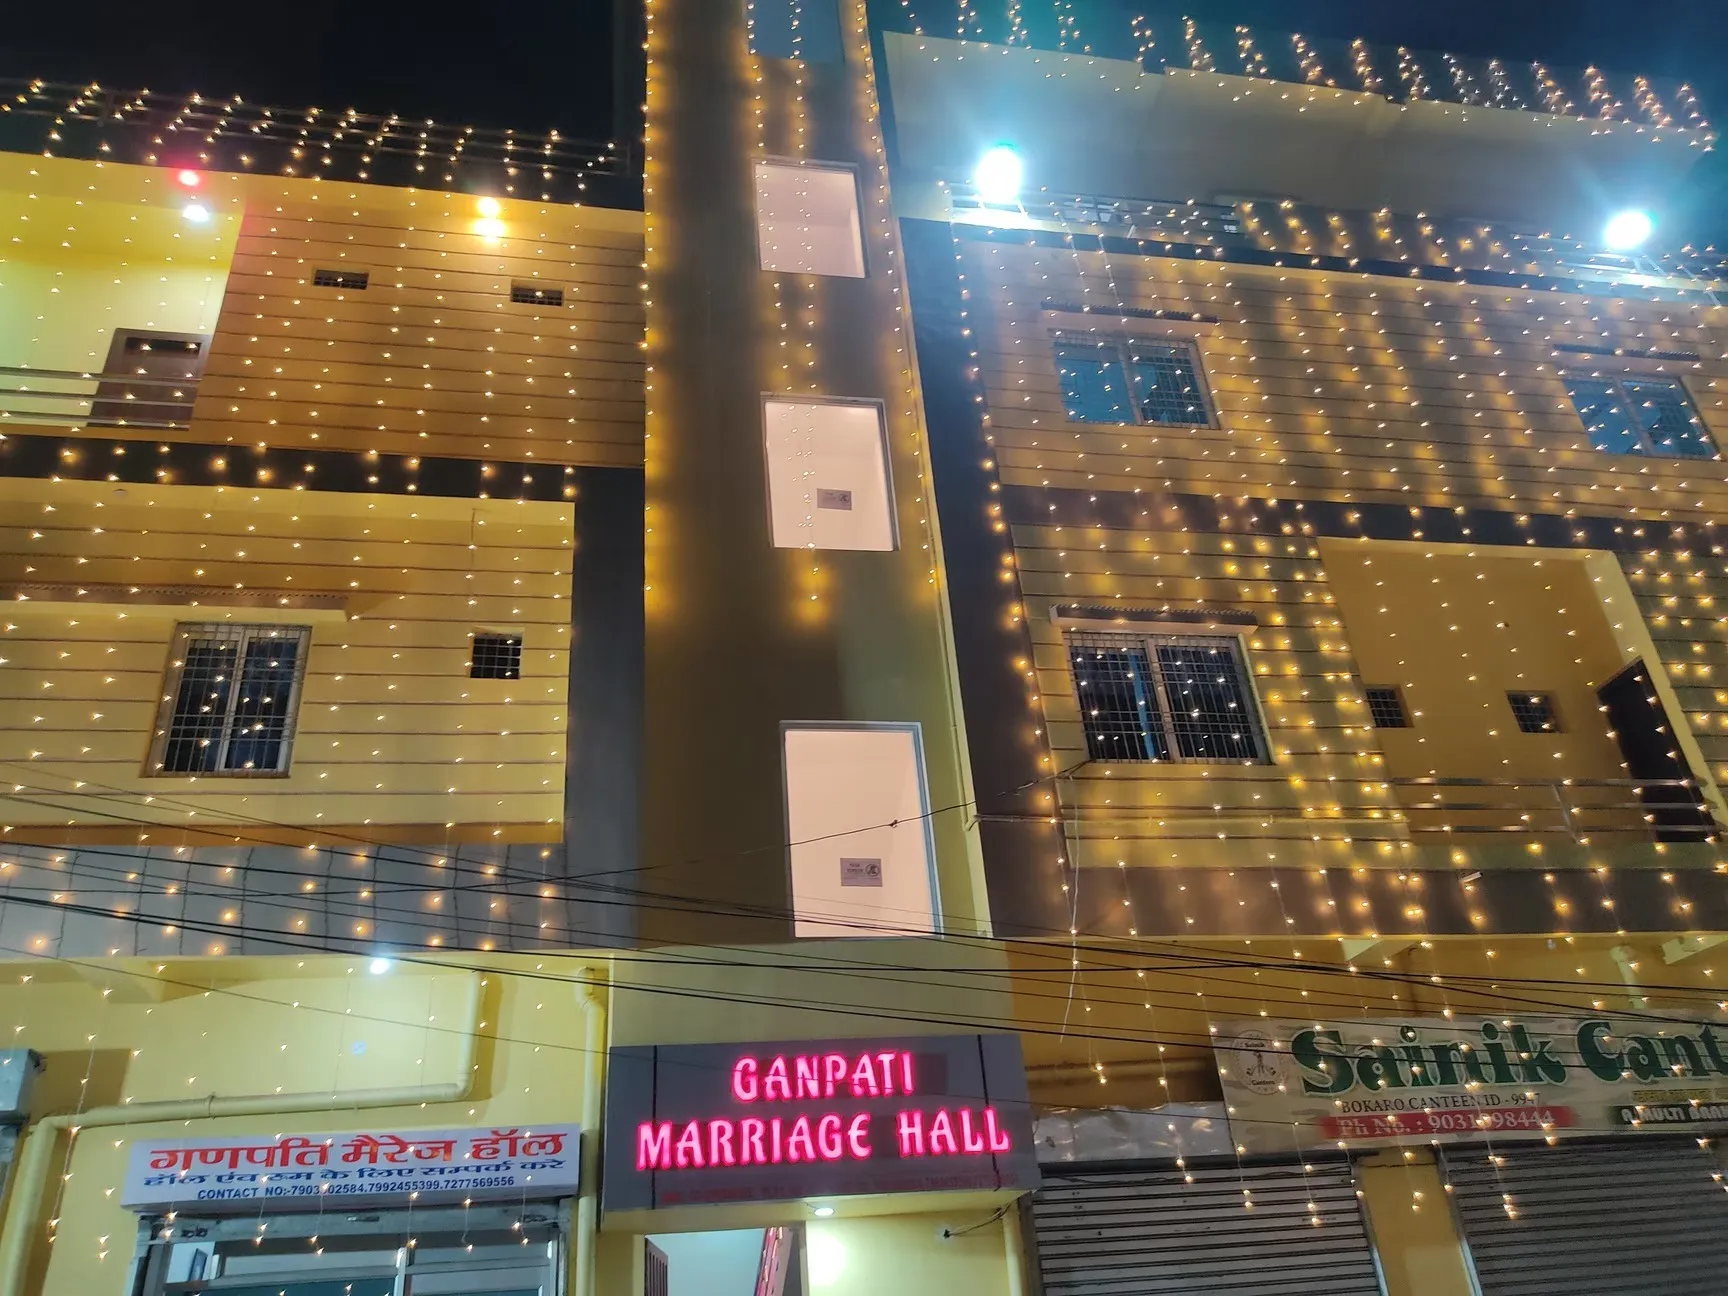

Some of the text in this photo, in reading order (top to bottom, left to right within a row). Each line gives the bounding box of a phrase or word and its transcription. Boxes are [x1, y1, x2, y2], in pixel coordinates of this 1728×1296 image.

[1291, 1019, 1568, 1096] Sainik
[732, 1052, 915, 1102] GANPATI
[1342, 1098, 1405, 1113] BOKARO
[1408, 1094, 1483, 1110] CANTEEN
[1485, 1093, 1501, 1106] ID
[636, 1104, 1012, 1170] MARRIAGE HALL
[1338, 1119, 1370, 1136] Ph
[150, 1129, 568, 1171] गणपति मैरेज हॉल
[320, 1168, 350, 1179] के
[356, 1166, 416, 1179] लिए
[197, 1187, 258, 1200] CONTACT
